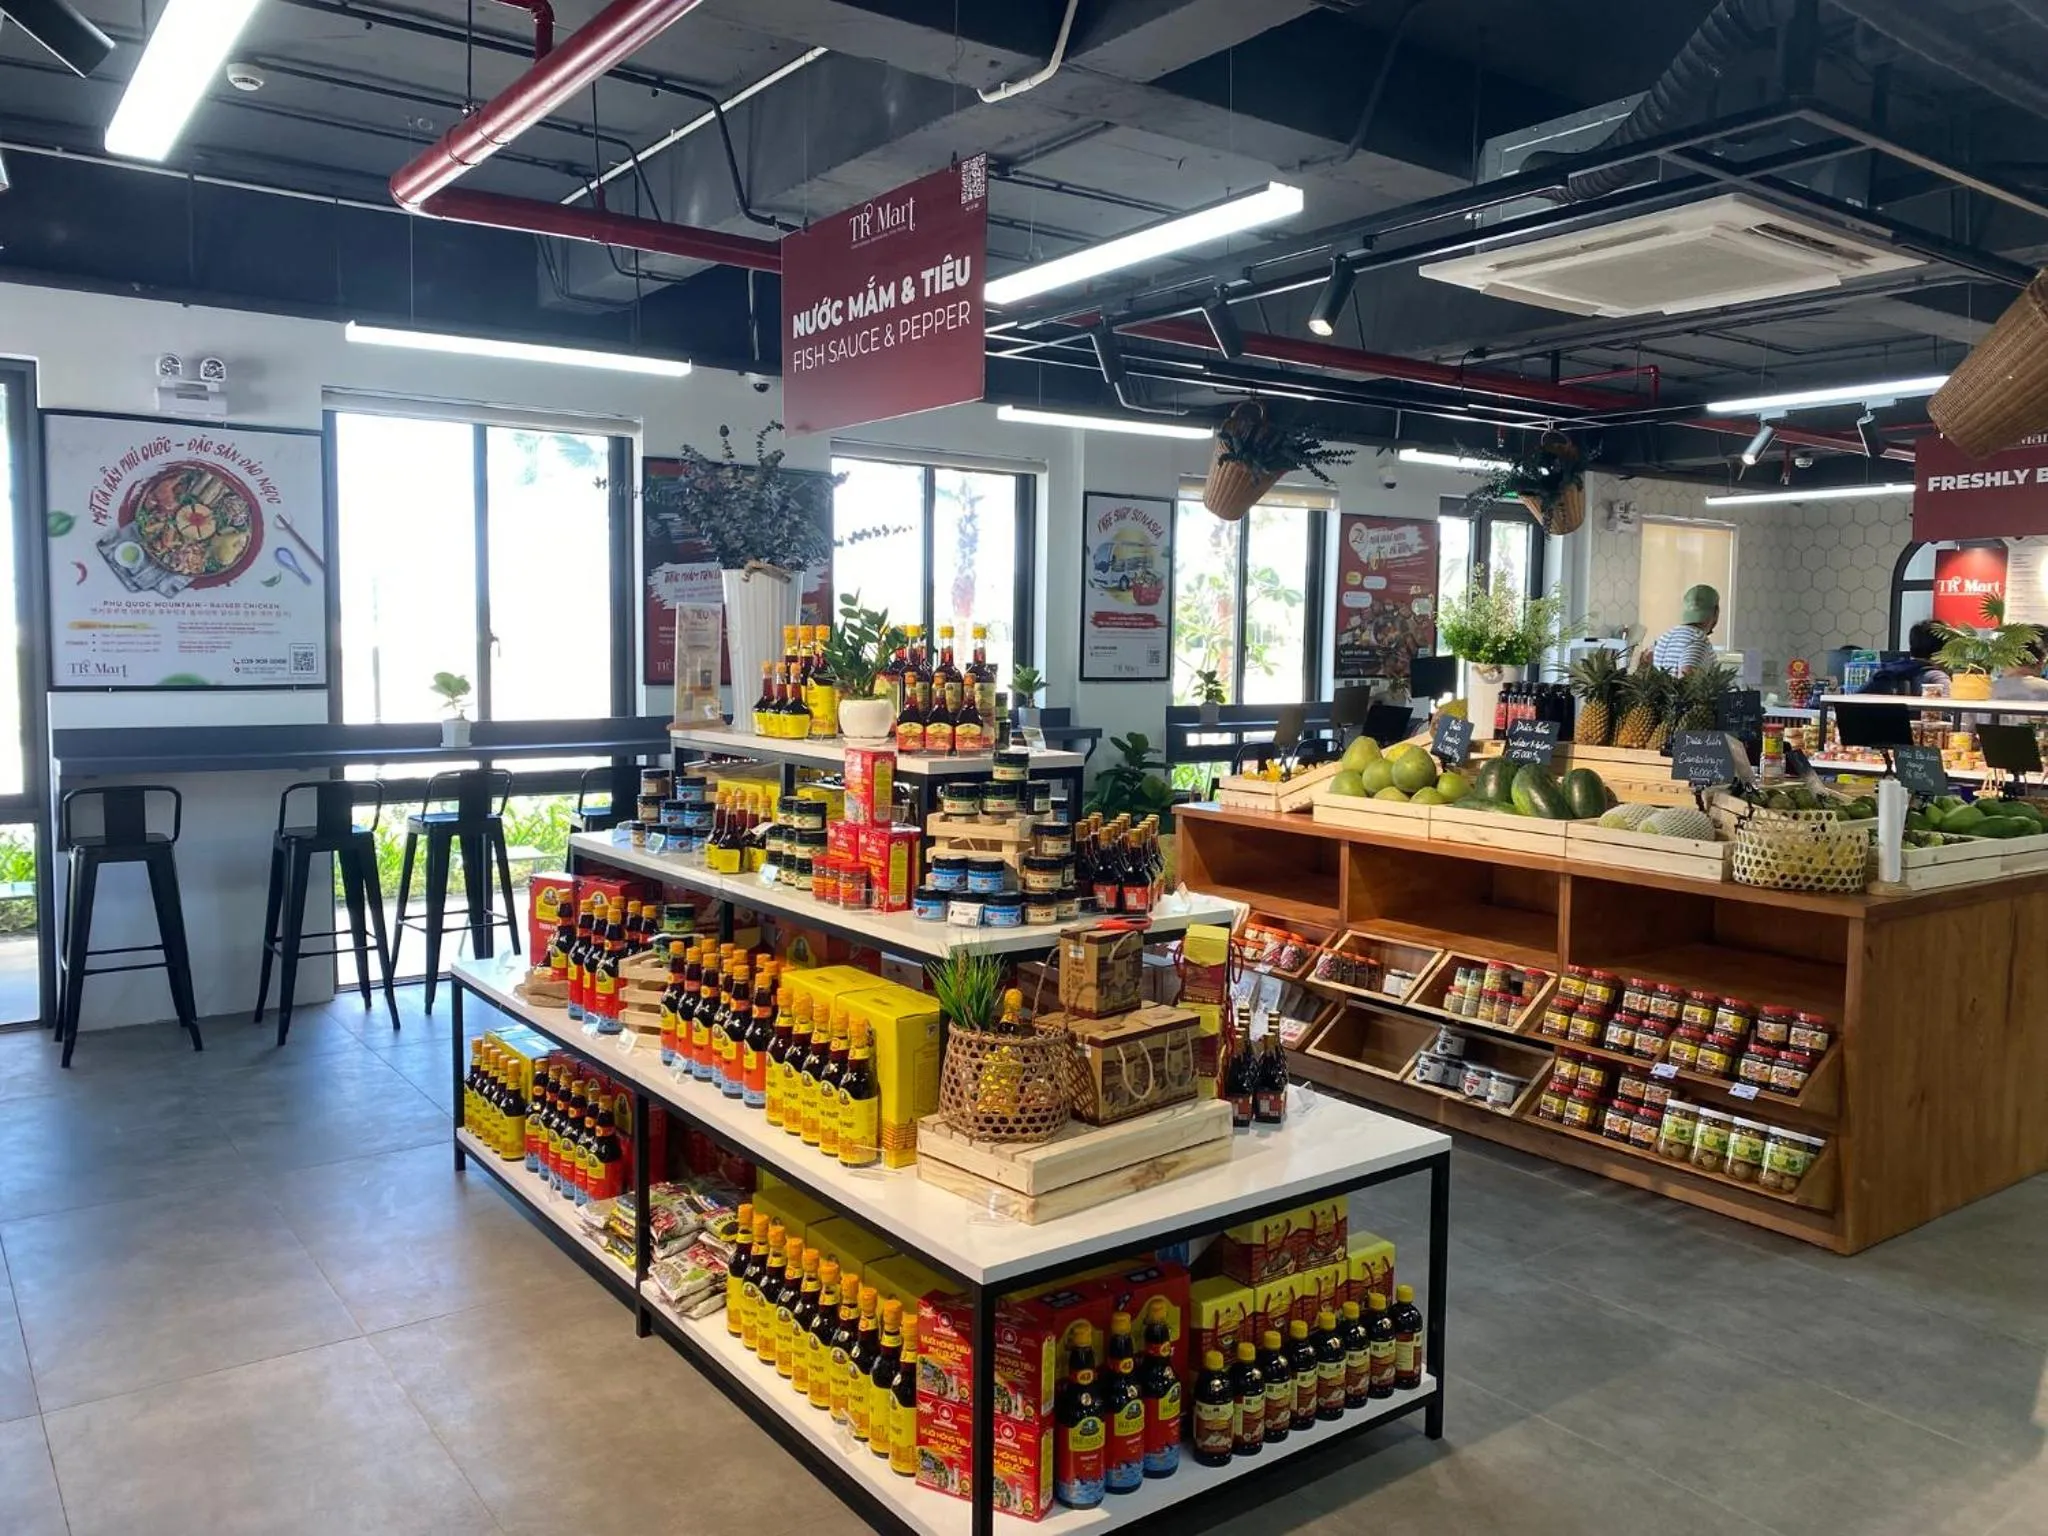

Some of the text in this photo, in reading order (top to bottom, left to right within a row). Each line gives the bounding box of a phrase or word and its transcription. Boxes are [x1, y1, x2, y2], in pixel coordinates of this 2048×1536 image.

[849, 202, 873, 242] TR
[877, 197, 916, 233] Mart
[793, 253, 971, 339] NƯỚC MẮM & TIÊU
[793, 300, 971, 374] FISH SAUCE & PEPPER
[1927, 468, 2030, 492] FRESHLY
[1964, 578, 2000, 594] Mart
[95, 661, 128, 678] Mart
